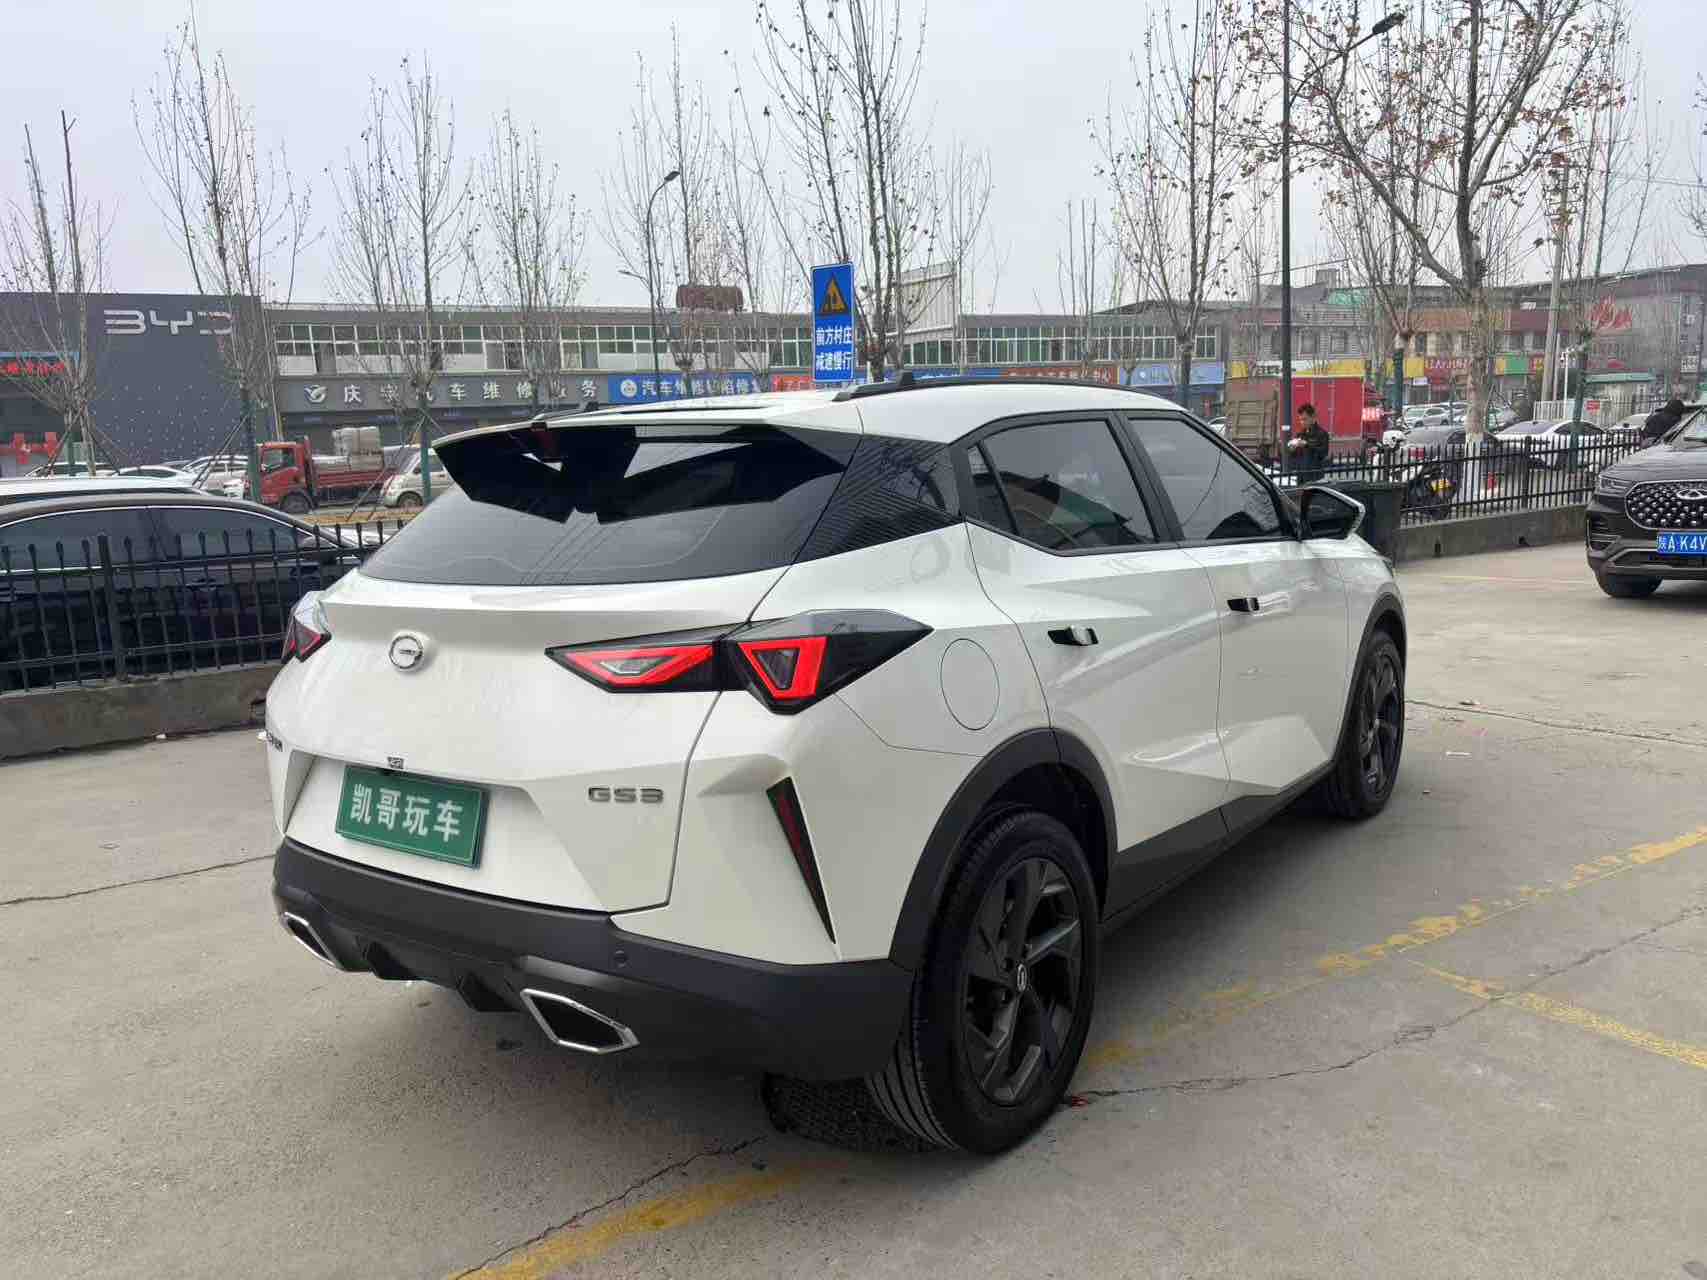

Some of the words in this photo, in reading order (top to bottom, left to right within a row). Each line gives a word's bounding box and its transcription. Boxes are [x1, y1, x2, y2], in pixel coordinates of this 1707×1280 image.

[103, 309, 232, 335] BYD
[816, 326, 852, 346] 前方村庄
[816, 351, 851, 371] 减速慢行
[343, 380, 597, 403] 庆车维修务
[588, 787, 663, 803] GS3
[350, 783, 463, 842] 凯哥玩车
